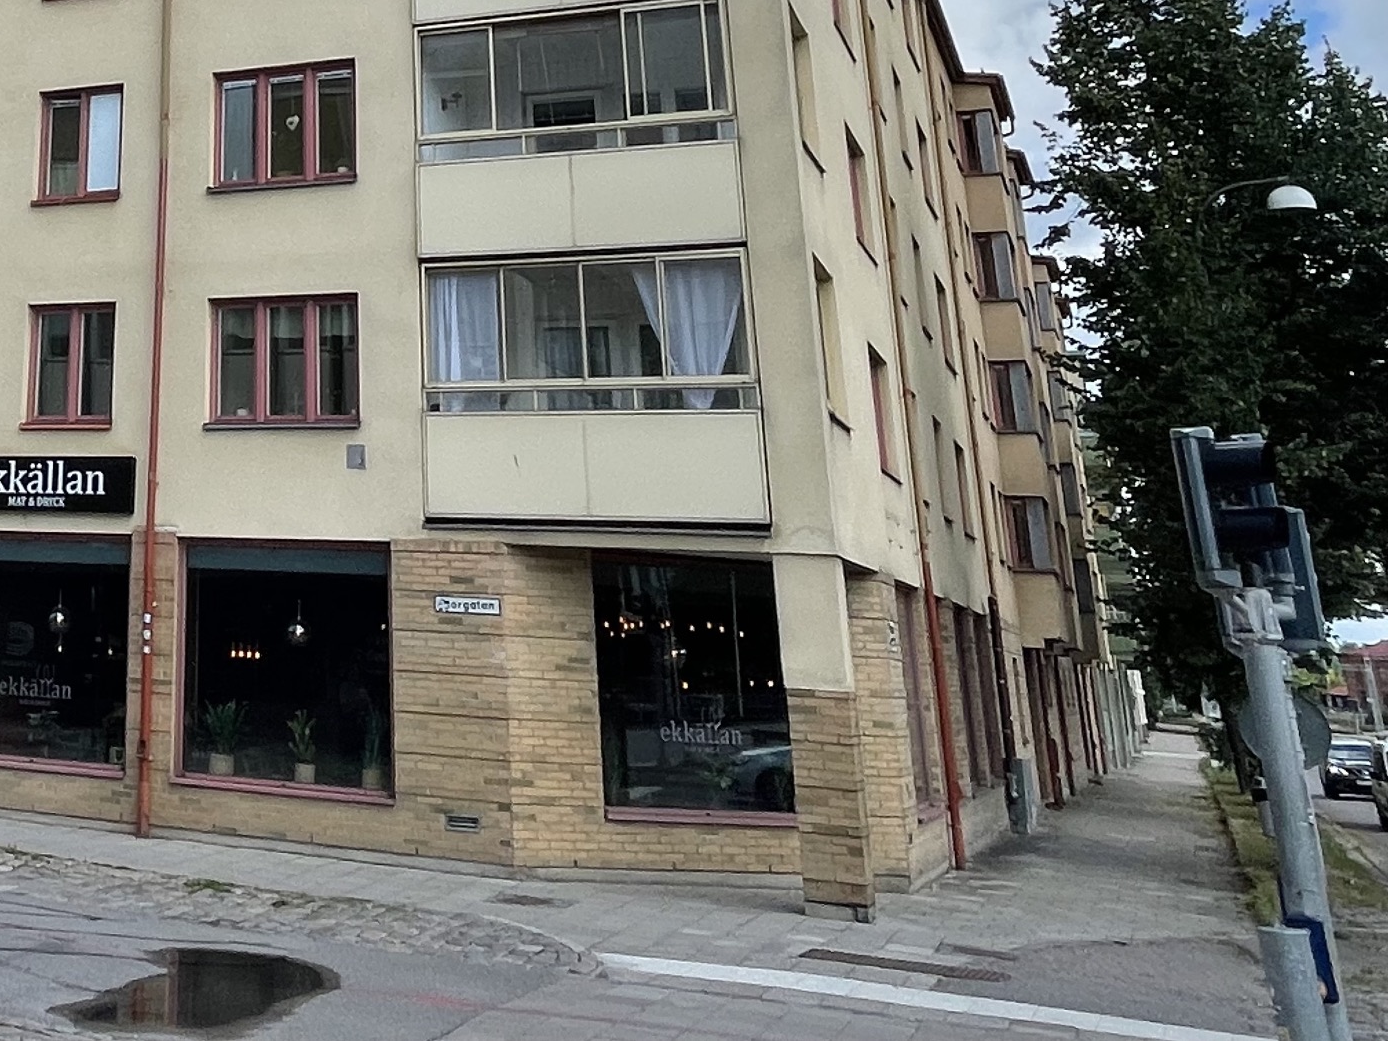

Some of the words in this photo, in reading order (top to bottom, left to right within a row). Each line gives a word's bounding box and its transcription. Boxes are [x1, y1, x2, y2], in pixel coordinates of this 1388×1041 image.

[8, 496, 28, 507] MAT
[28, 496, 35, 507] &
[438, 599, 495, 613] orgatan
